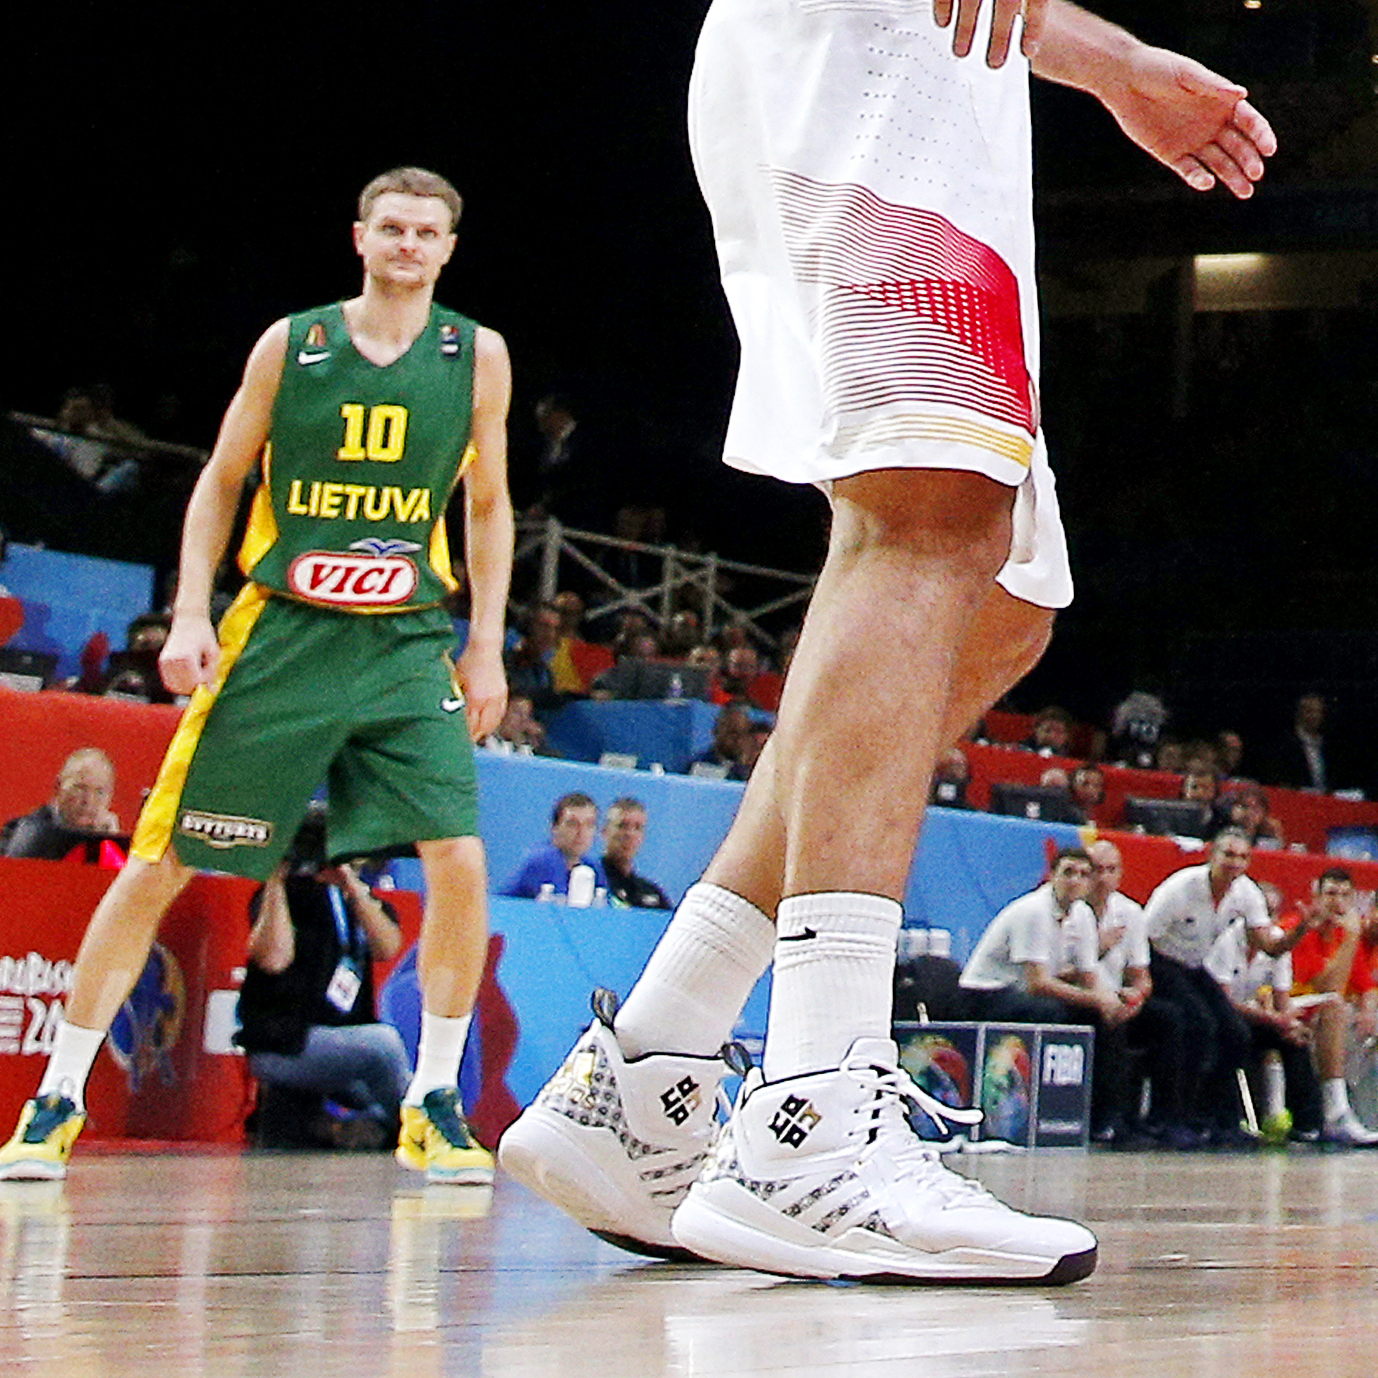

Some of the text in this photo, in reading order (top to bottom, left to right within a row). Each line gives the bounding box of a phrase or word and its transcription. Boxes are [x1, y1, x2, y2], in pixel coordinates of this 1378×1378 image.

[336, 403, 409, 463] 10
[286, 479, 431, 524] LIETUVA
[309, 562, 405, 596] VICI
